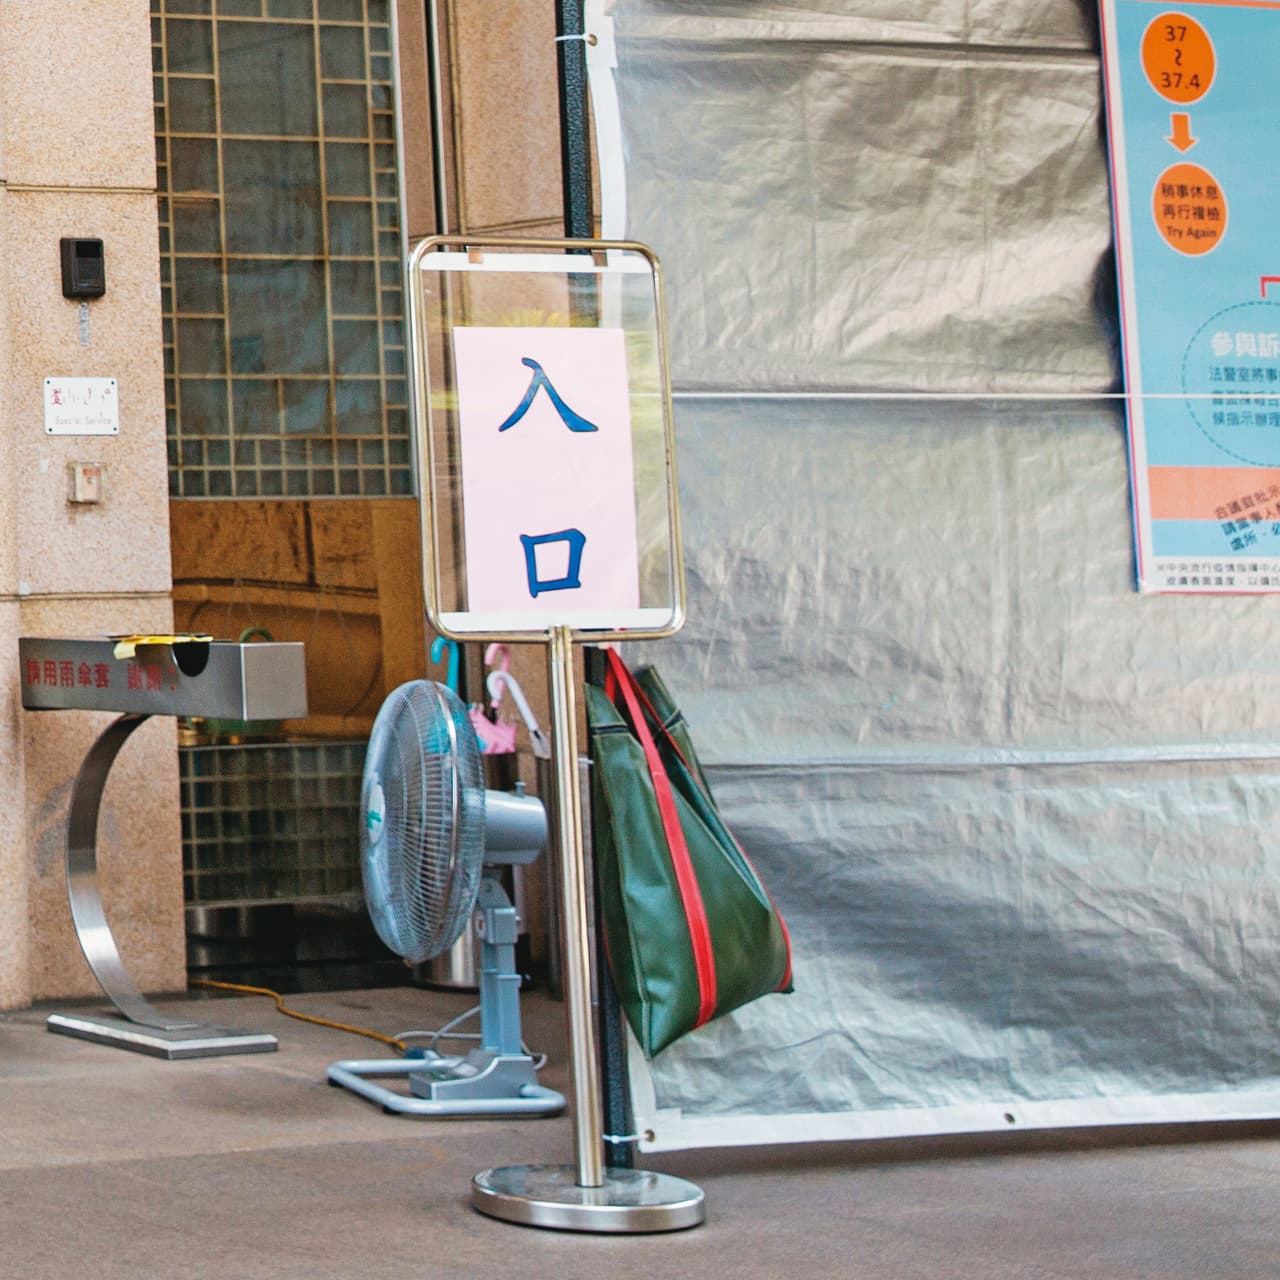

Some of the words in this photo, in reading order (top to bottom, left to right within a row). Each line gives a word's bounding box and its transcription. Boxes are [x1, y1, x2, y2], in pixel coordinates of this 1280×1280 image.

[1165, 25, 1187, 42] 37
[1160, 71, 1201, 90] 37.4
[1167, 225, 1183, 238] Try
[1186, 226, 1217, 240] Again
[498, 356, 599, 599] 入口
